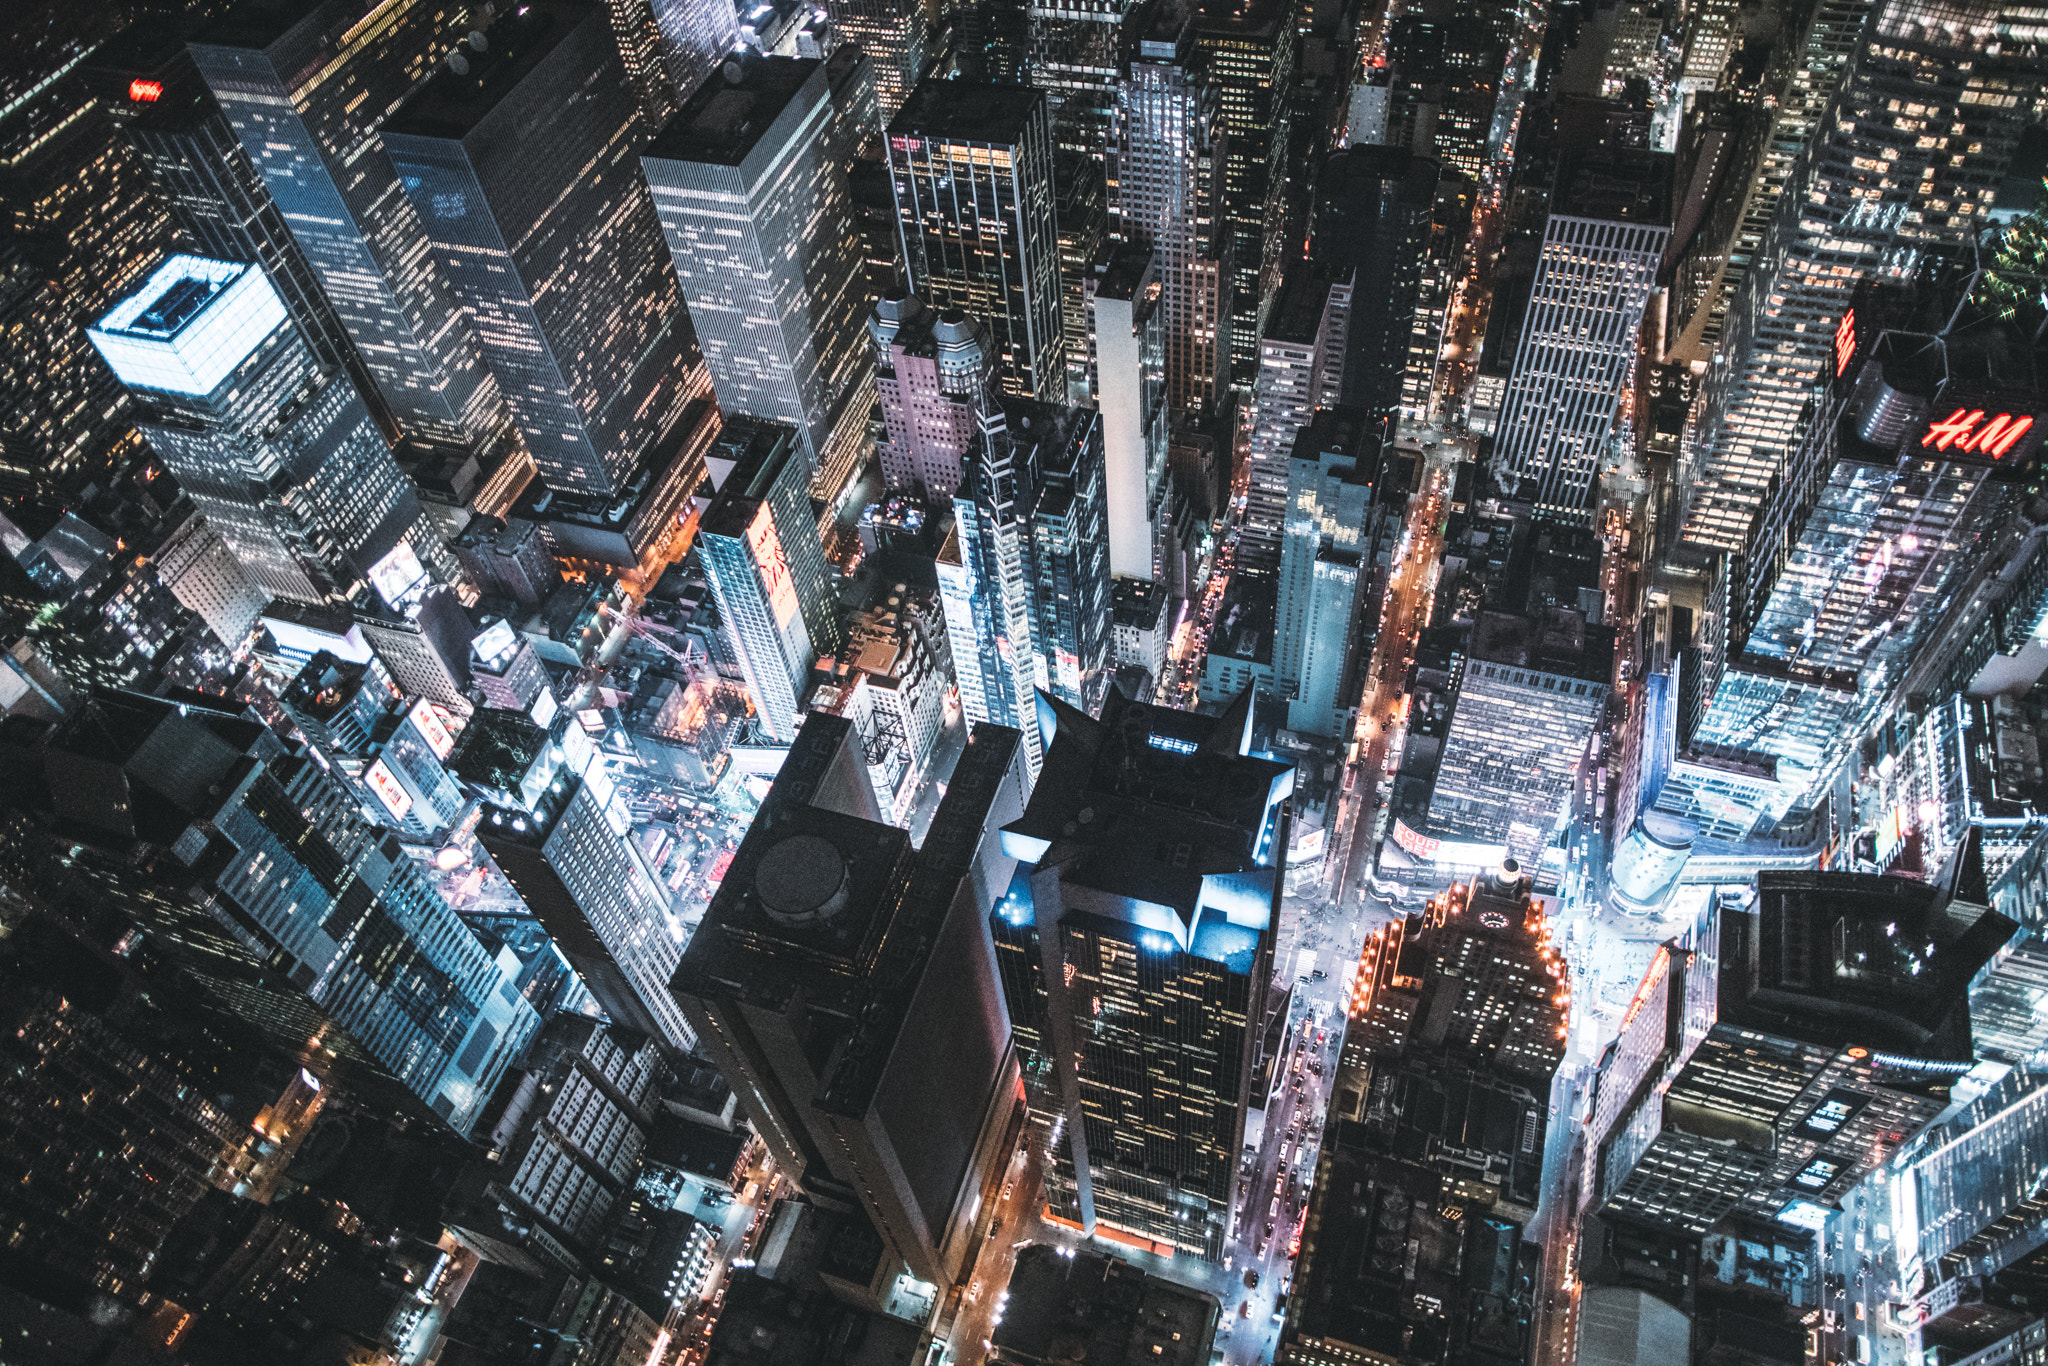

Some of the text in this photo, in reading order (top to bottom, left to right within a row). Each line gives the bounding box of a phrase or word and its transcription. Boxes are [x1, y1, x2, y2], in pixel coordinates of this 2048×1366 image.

[1836, 308, 1855, 377] H&M
[1921, 407, 2033, 460] H&M
[1397, 823, 1437, 849] COUR
